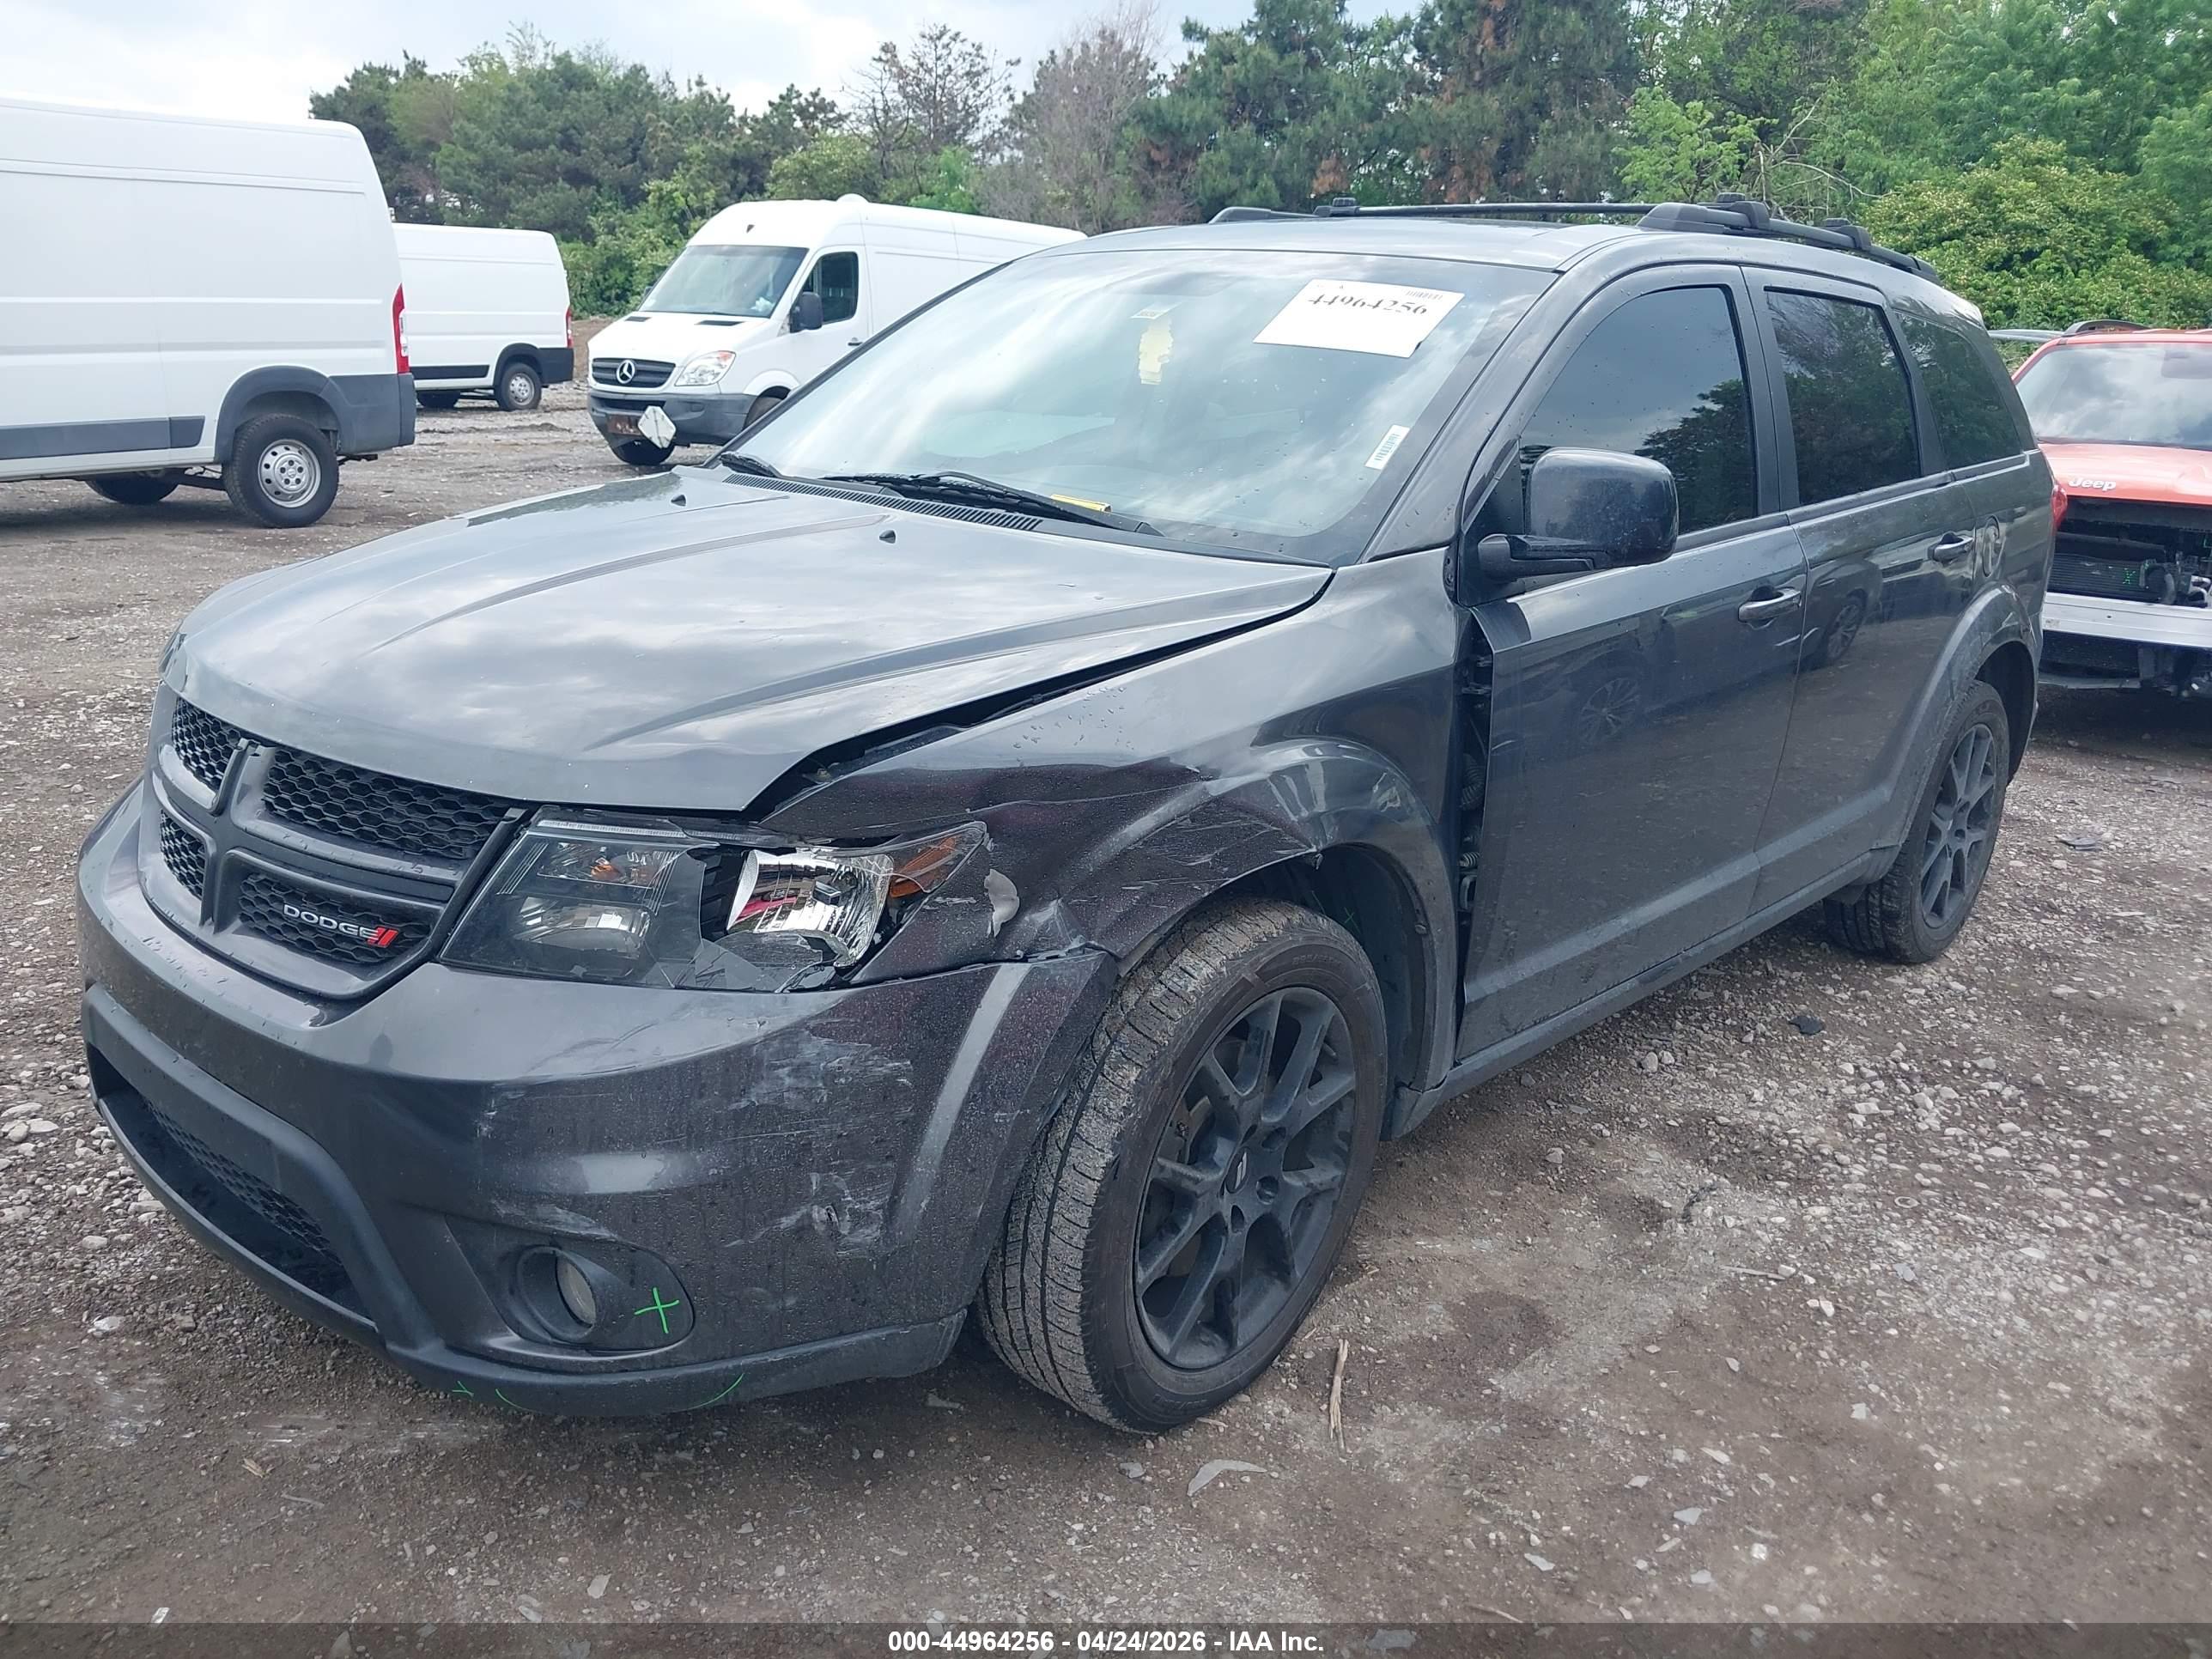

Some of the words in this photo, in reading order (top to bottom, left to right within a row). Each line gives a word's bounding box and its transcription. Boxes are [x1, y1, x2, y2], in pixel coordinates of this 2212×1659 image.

[1307, 294, 1427, 315] 44964256
[2067, 477, 2117, 493] Jeep
[283, 903, 380, 941] DODGE
